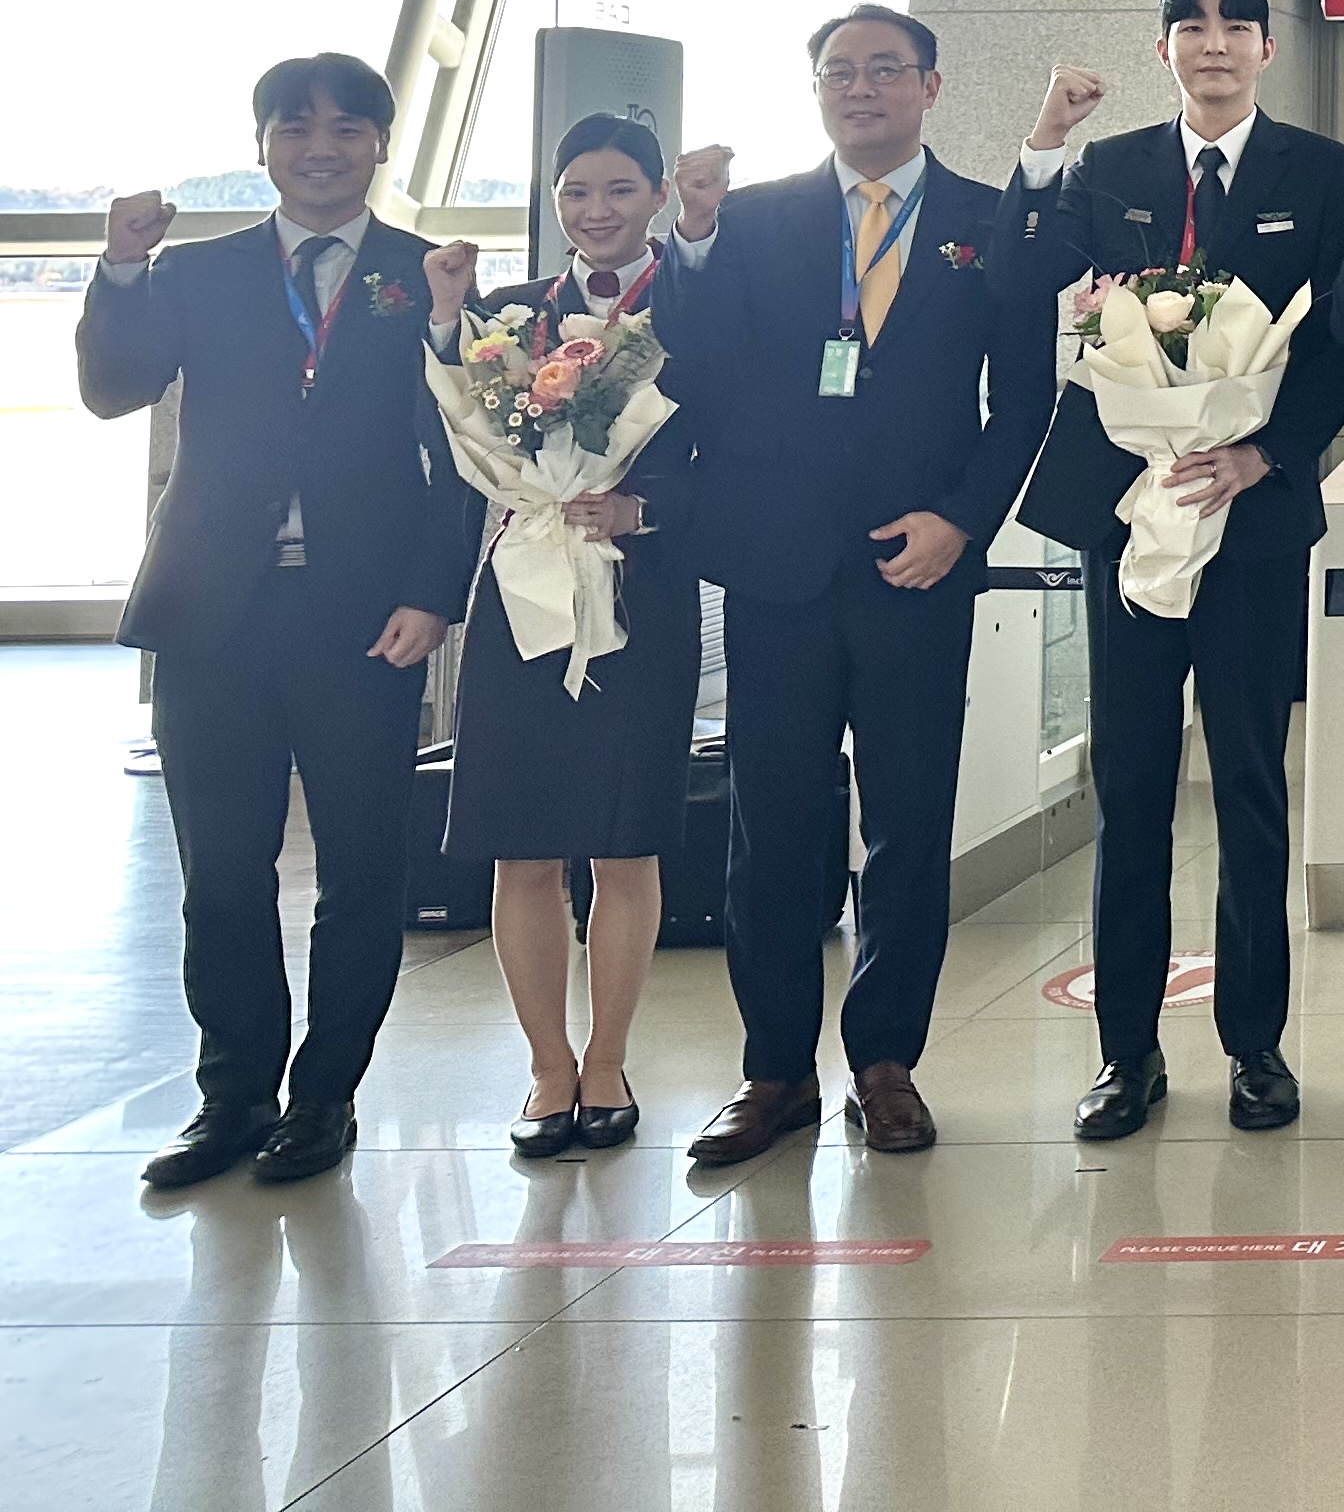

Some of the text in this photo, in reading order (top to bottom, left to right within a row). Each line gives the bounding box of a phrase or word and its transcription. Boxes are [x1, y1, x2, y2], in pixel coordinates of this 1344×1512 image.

[1120, 1245, 1182, 1254] PLEASE
[1185, 1244, 1239, 1254] QUEUE
[1242, 1244, 1285, 1252] HERE
